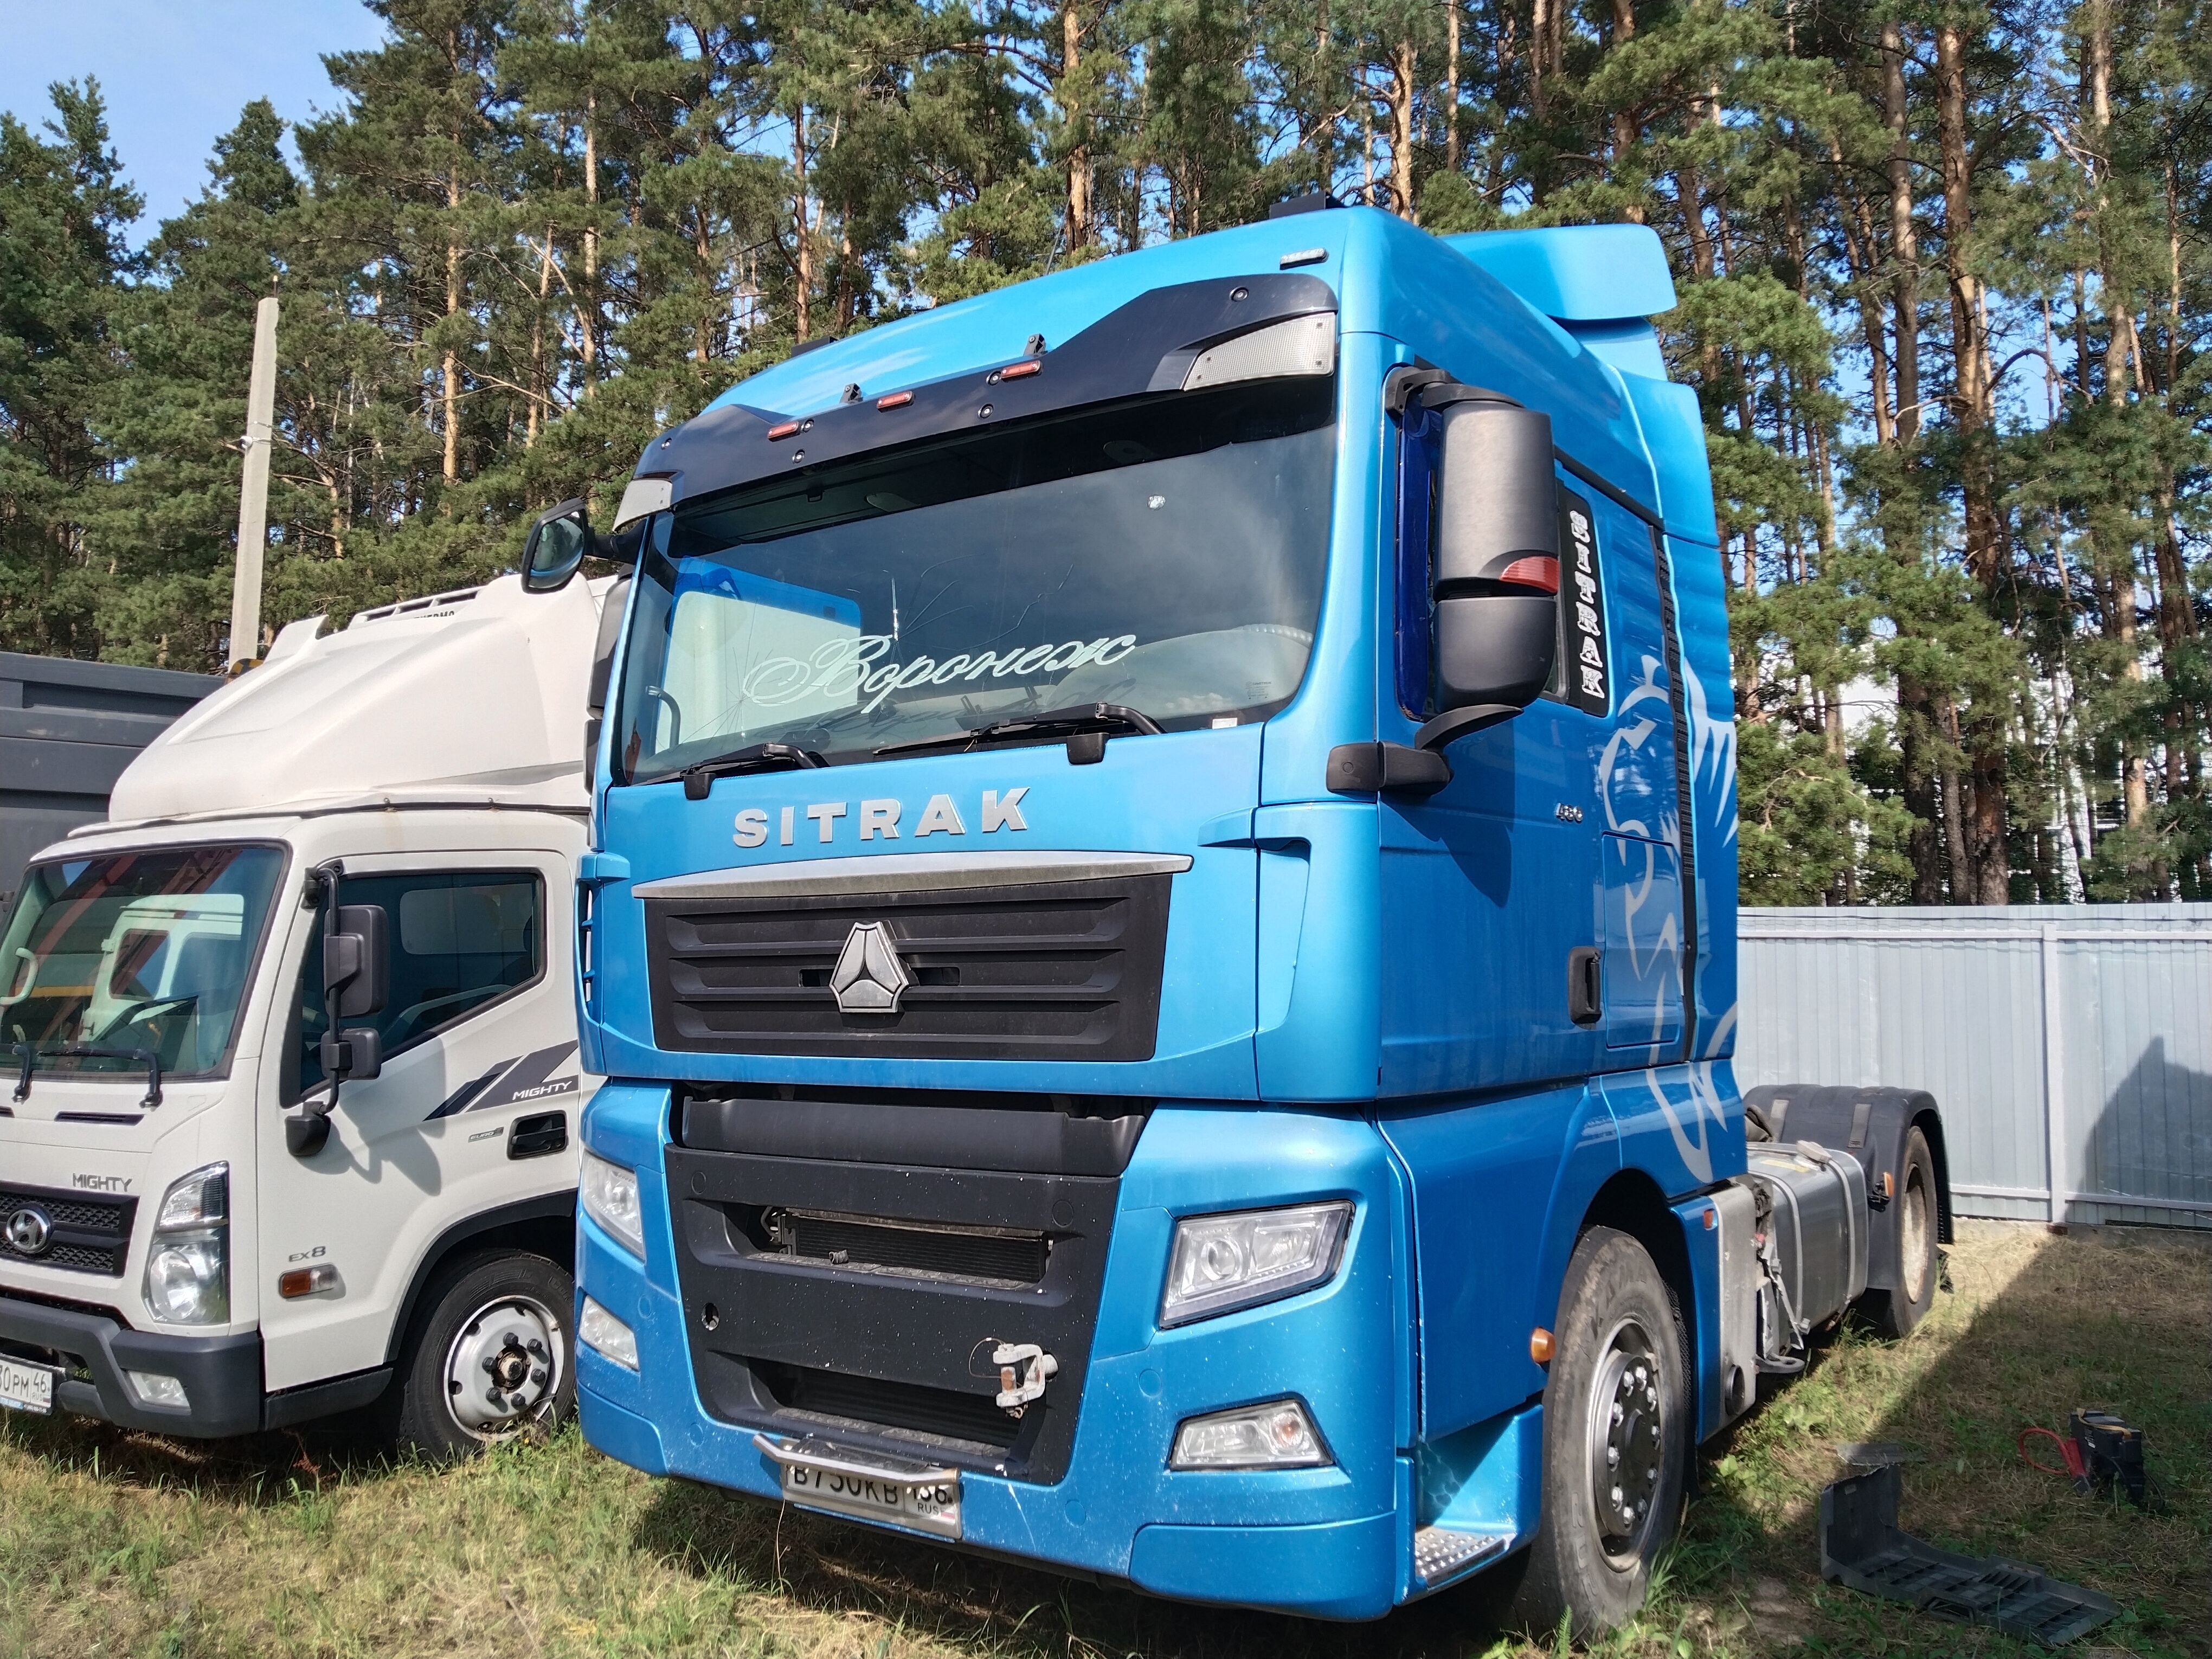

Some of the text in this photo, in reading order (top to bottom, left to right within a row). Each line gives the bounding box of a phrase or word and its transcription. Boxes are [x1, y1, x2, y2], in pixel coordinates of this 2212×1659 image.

[743, 634, 1136, 713] Воронеж
[733, 786, 1030, 847] SITRAK
[512, 1081, 572, 1100] MIGHTY
[470, 1131, 494, 1140] EURO
[72, 1172, 133, 1192] MIGHTY
[33, 1372, 47, 1393] 46
[32, 1392, 43, 1401] RUS
[917, 1503, 939, 1516] RUS
